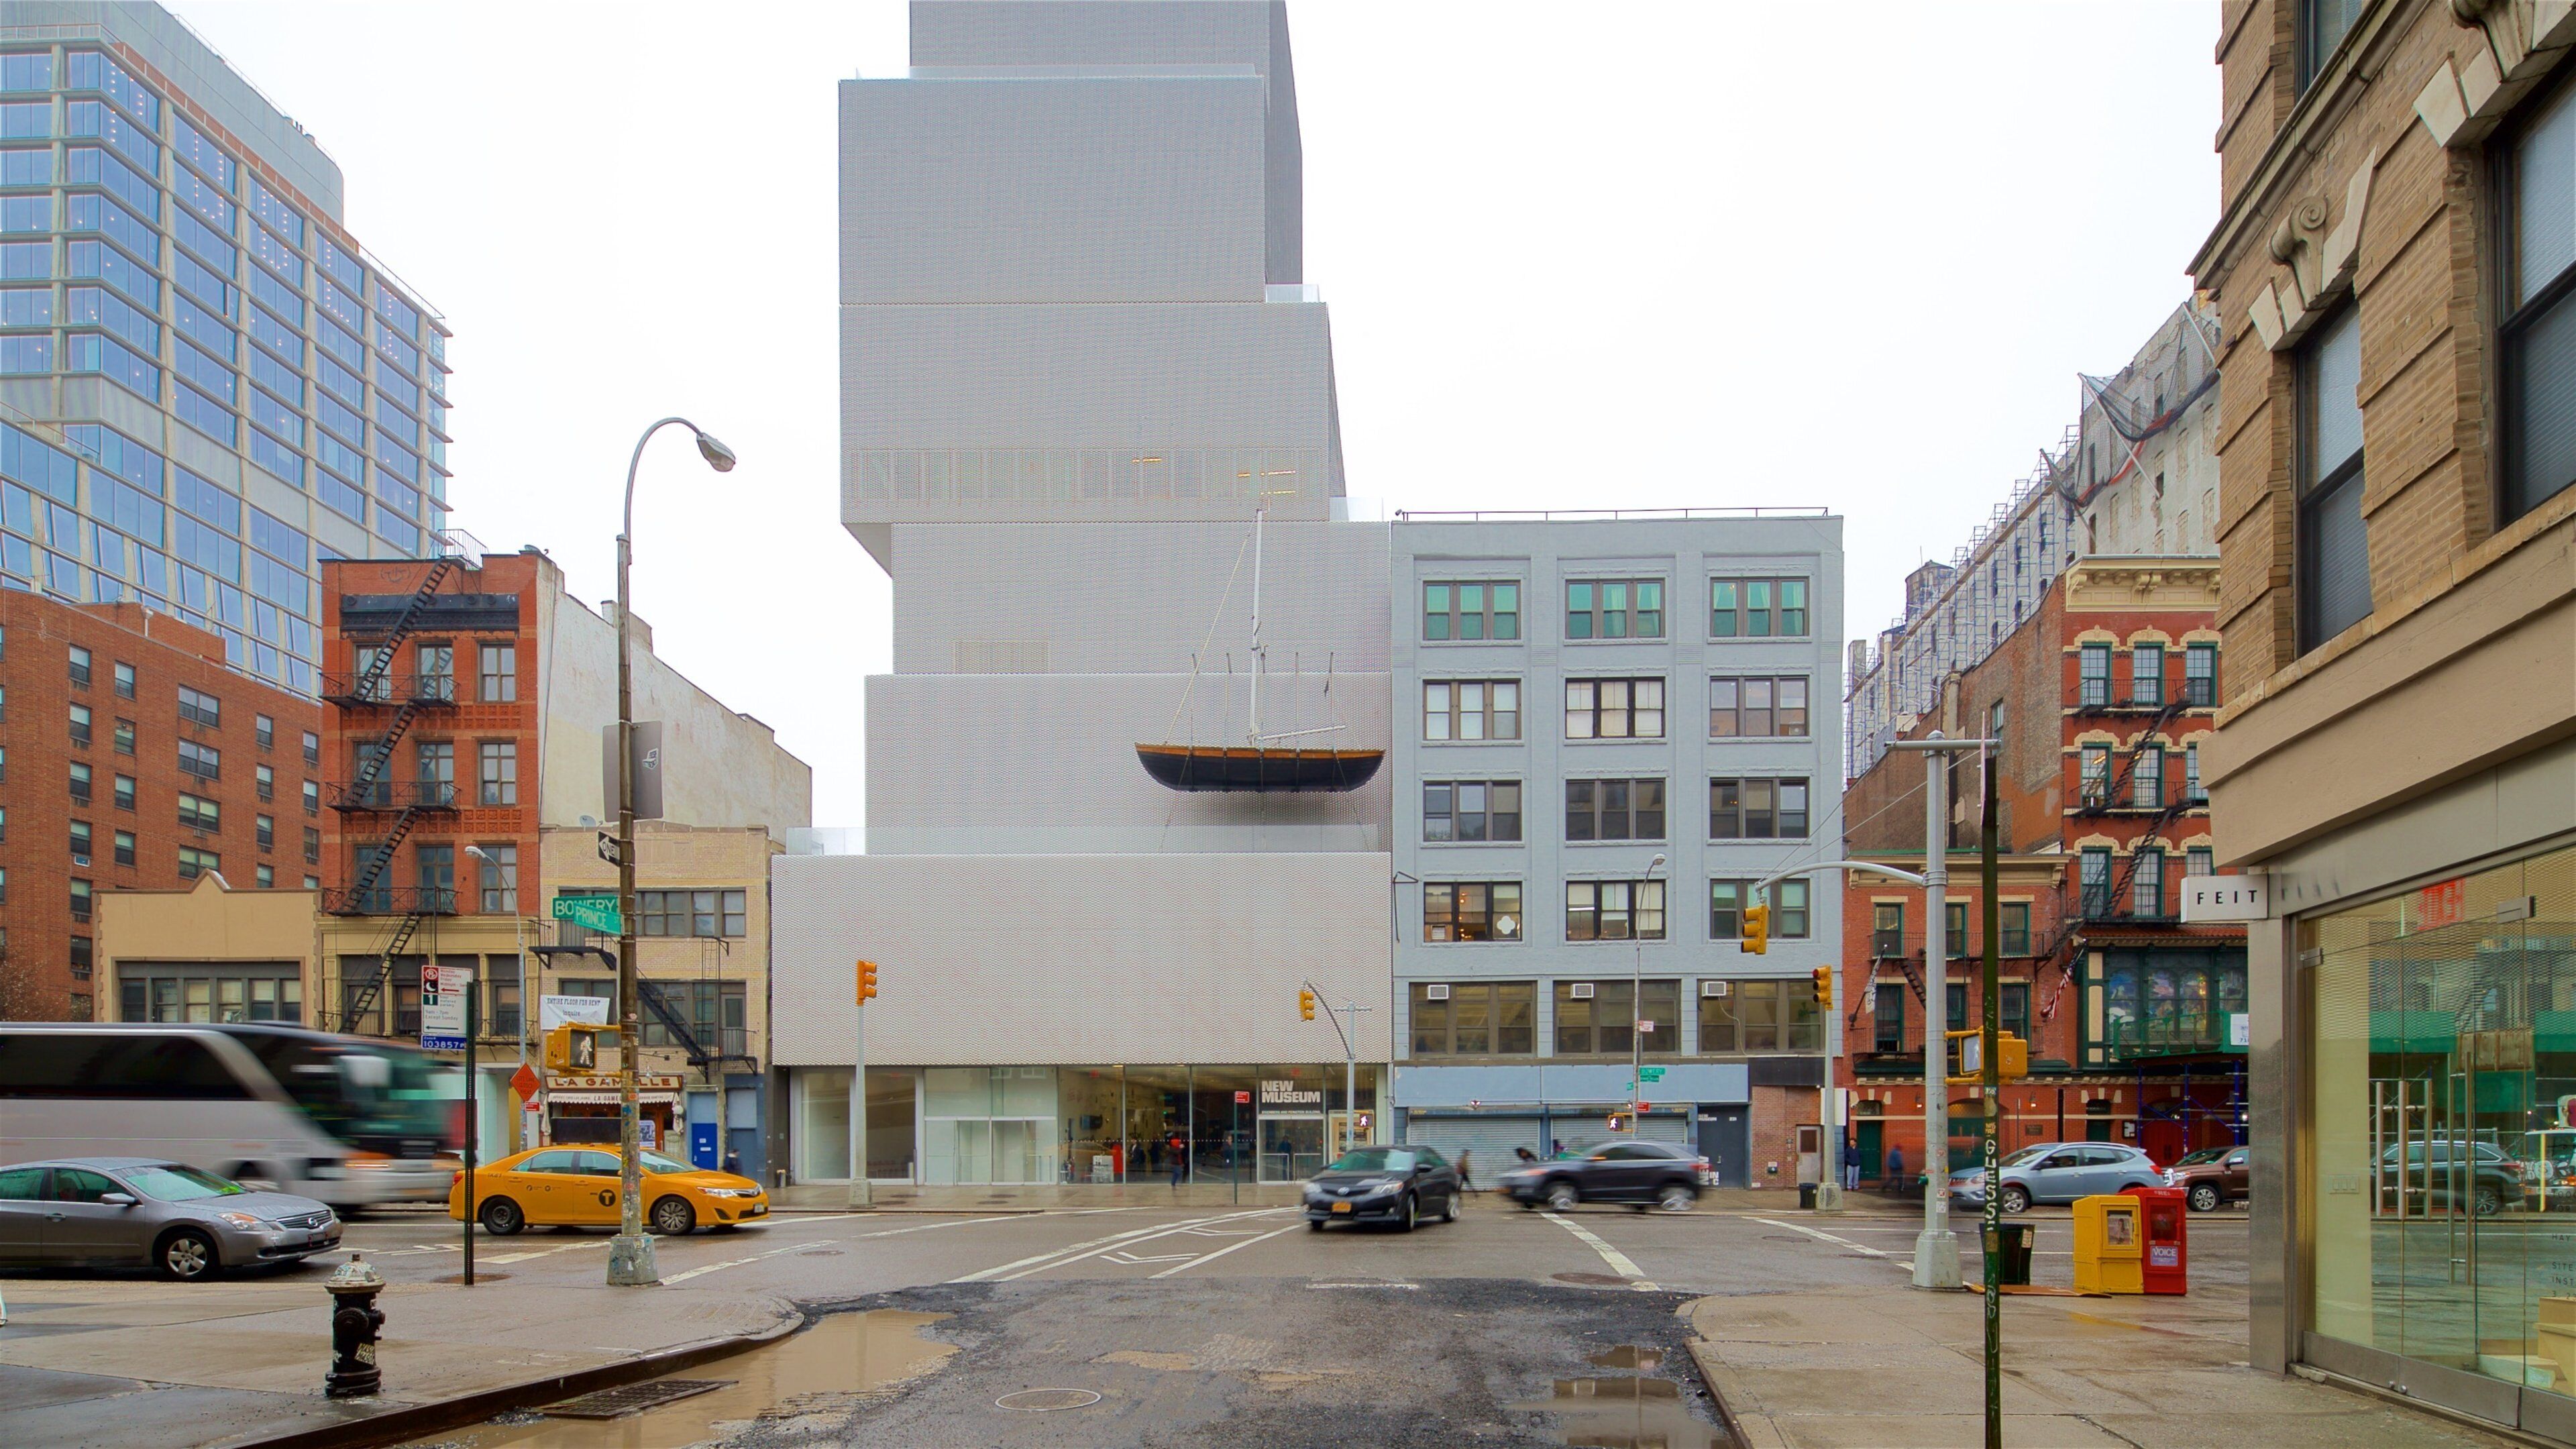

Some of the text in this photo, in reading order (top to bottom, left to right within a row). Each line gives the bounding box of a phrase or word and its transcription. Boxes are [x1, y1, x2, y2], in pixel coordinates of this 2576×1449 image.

[602, 841, 616, 856] ONE
[2197, 890, 2257, 905] FEIT
[576, 906, 607, 928] PRINCE
[428, 995, 433, 1005] 1
[586, 1078, 671, 1086] GAMLLE
[1262, 1081, 1293, 1091] NEW
[1262, 1091, 1320, 1103] MUSEUM
[2153, 1247, 2176, 1256] VOICE
